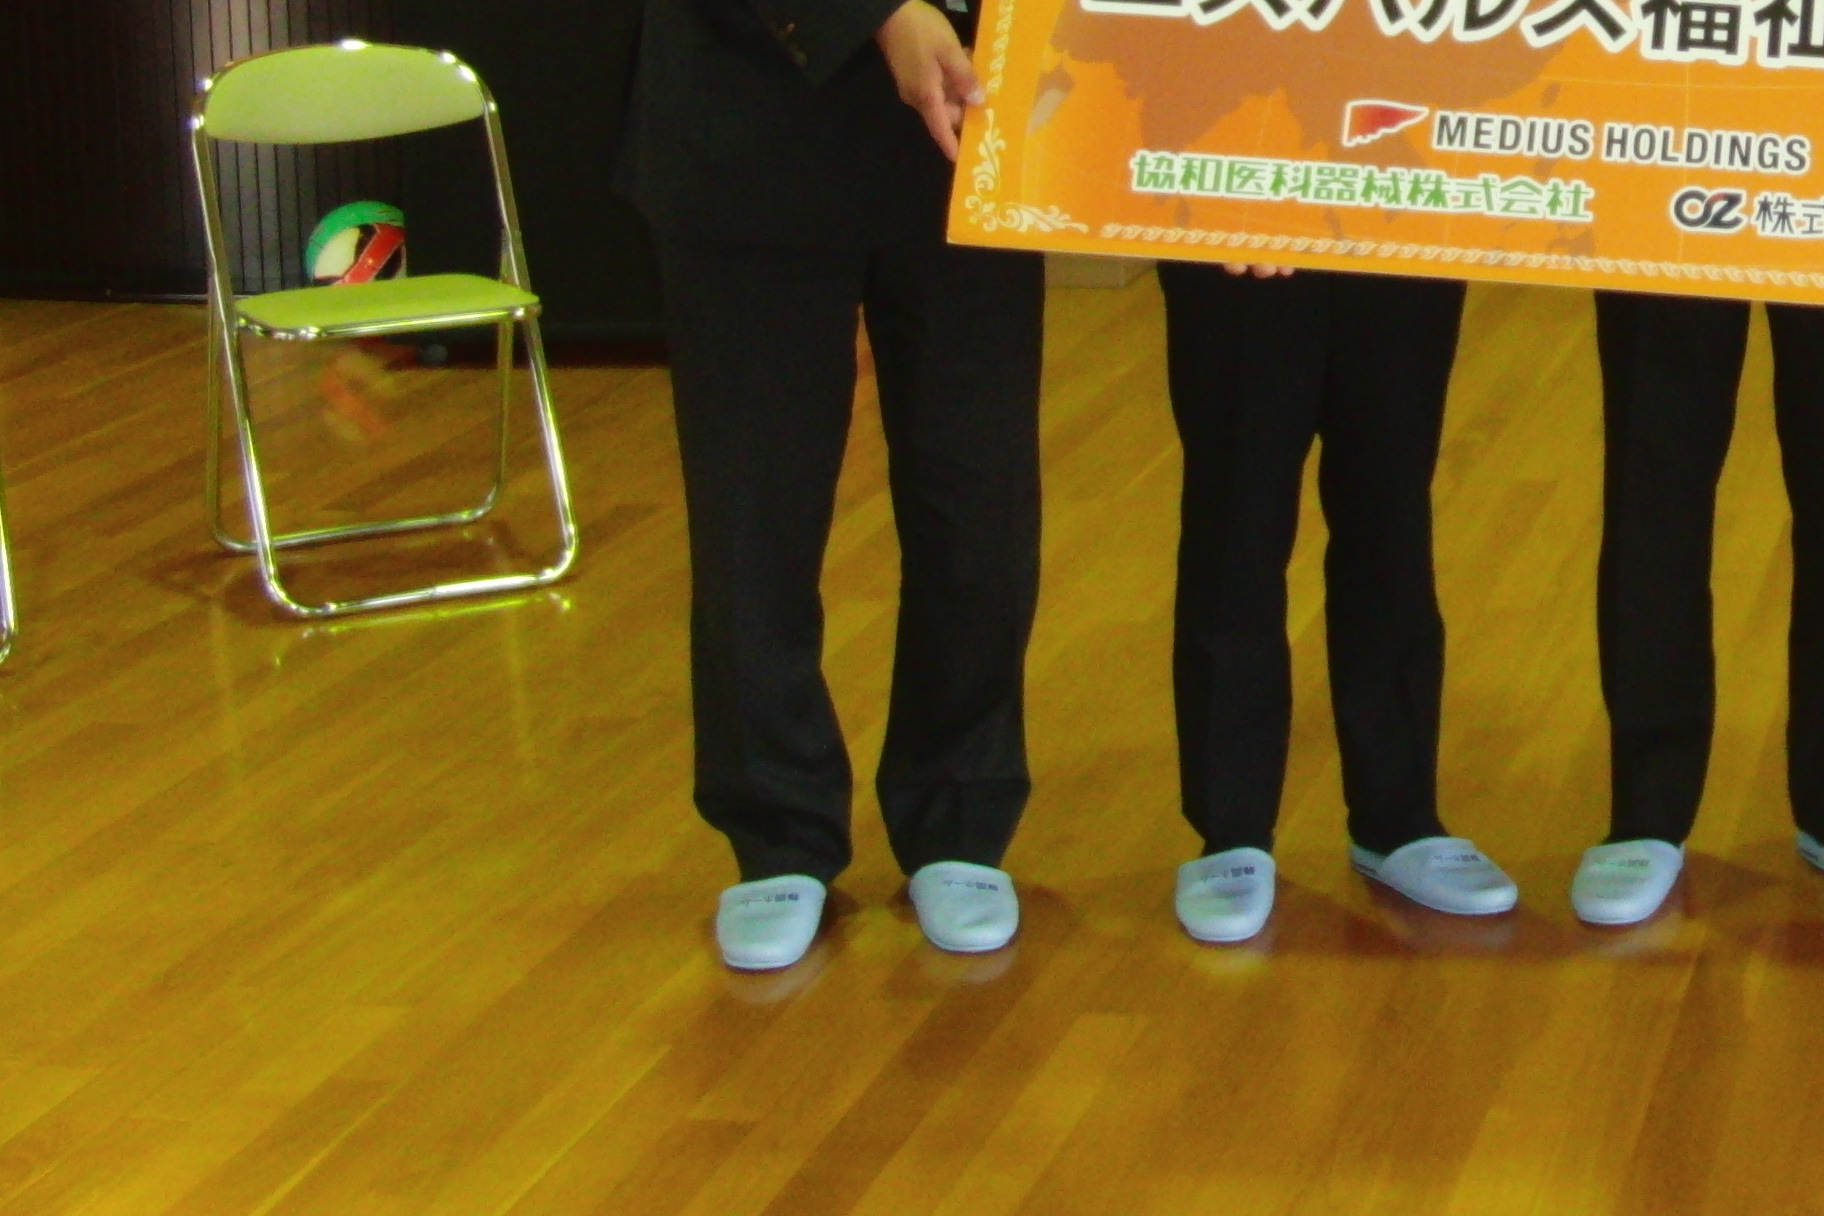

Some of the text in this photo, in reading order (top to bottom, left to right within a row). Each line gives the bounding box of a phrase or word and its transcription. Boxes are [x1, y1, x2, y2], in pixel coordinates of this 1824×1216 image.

[1435, 114, 1810, 172] MEDIUS HOLDINGS
[1132, 153, 1594, 220] 協和医科器械株式会社
